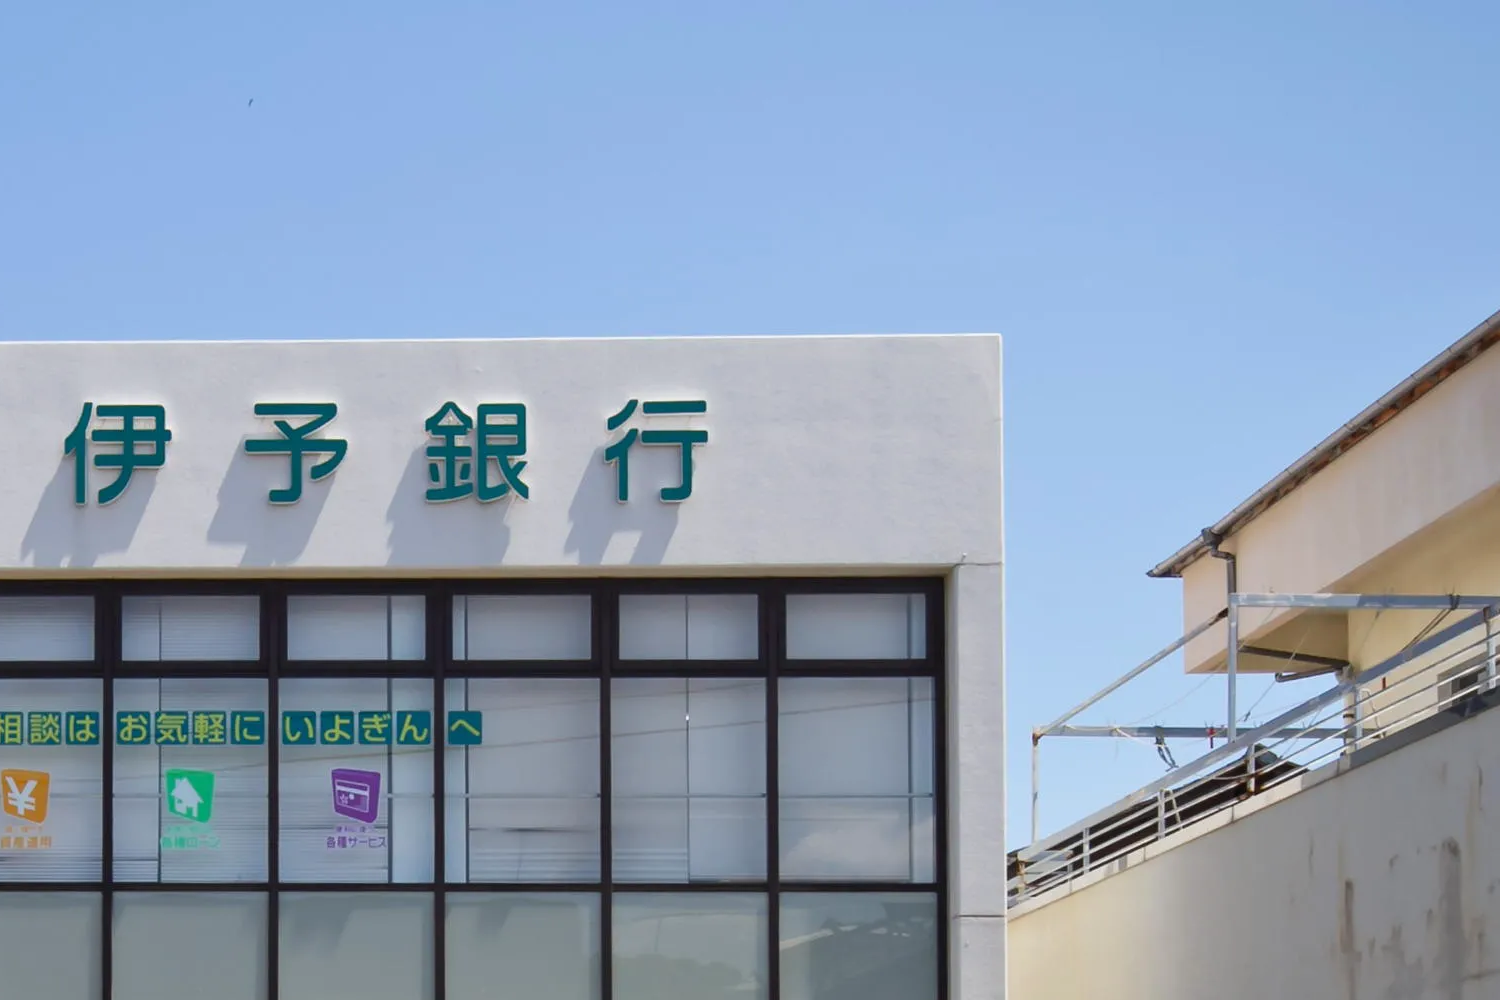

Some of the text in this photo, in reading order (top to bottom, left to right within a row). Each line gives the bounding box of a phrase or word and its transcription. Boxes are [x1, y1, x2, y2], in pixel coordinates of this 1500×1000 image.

[64, 400, 708, 505] 伊予銀行
[119, 713, 264, 744] お気軽に
[283, 712, 429, 744] いよぎん
[326, 836, 387, 849] 各種サービス
